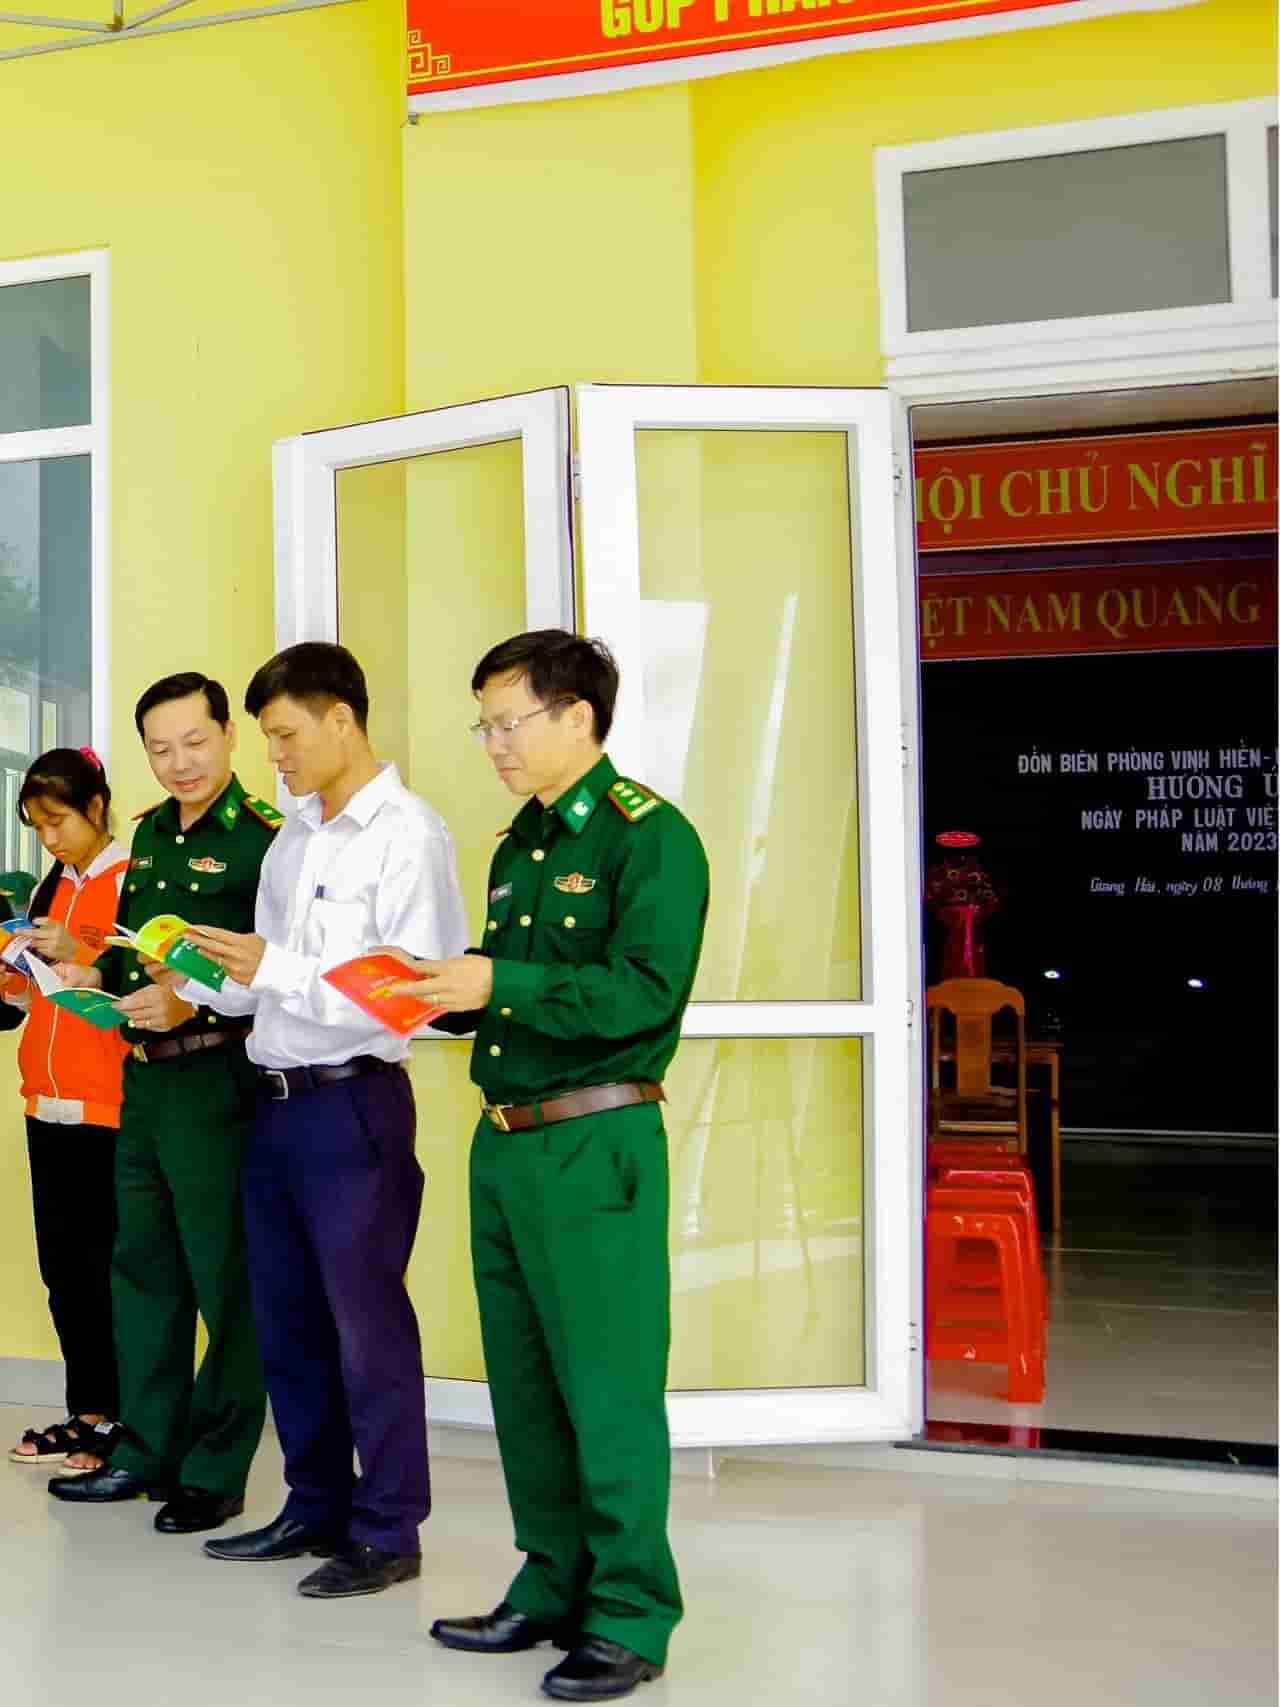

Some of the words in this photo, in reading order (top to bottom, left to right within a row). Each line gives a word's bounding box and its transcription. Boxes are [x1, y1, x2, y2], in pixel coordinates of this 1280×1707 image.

[999, 450, 1111, 518] CHỦ
[1126, 441, 1278, 512] NGHĨ
[919, 592, 972, 650] ỆT
[984, 592, 1081, 635] NAM
[1096, 581, 1261, 640] QUANG
[1081, 803, 1122, 830] NGÀY
[1135, 803, 1183, 830] PHÁP
[1194, 803, 1236, 831] LUẬT
[1227, 831, 1278, 852] 2023
